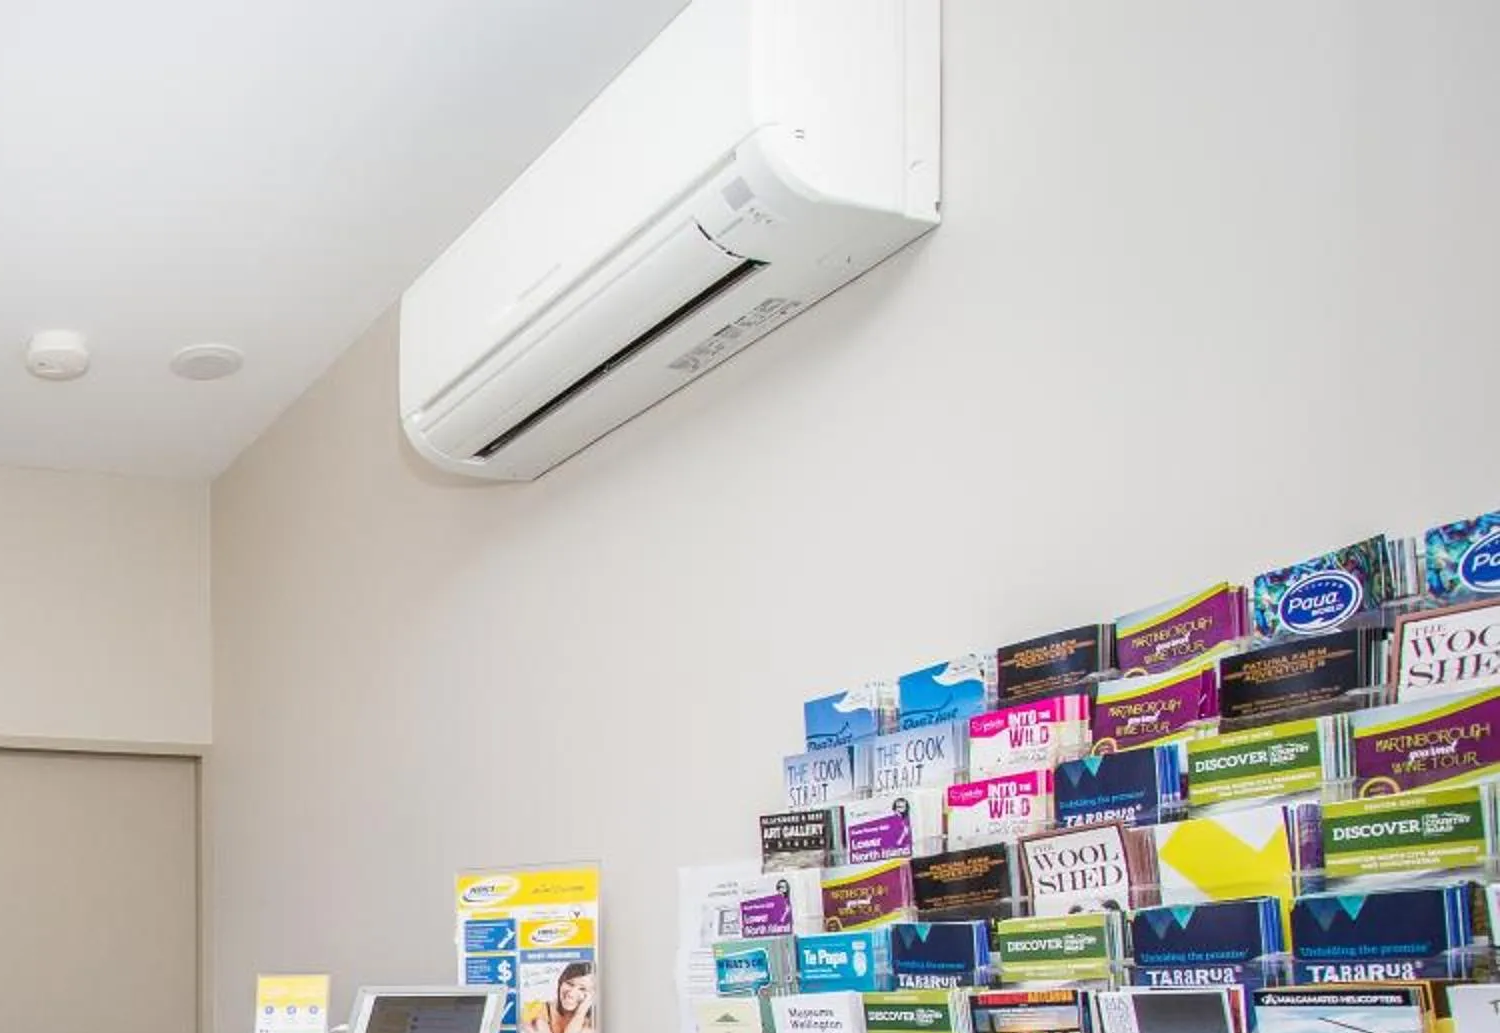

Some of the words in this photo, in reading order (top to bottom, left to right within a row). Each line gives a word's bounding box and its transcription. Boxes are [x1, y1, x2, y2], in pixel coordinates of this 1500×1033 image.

[1410, 624, 1500, 658] WOO
[1407, 652, 1500, 688] SHE
[1007, 709, 1037, 727] INTO
[1008, 725, 1049, 749] WILD
[1376, 723, 1491, 753] MARTINBOROUGH
[876, 744, 901, 766] THE
[905, 735, 946, 763] COOK
[1195, 751, 1268, 773] DISCOVER
[1431, 752, 1480, 770] TOUR
[787, 764, 809, 783] THE
[812, 758, 844, 781] COOK
[876, 764, 924, 792] STRAIT
[987, 781, 1017, 798] INTO
[988, 798, 1031, 819] WILD
[782, 824, 824, 838] GALLERY
[1332, 818, 1421, 841] DISCOVER
[851, 850, 880, 862] North
[1033, 843, 1119, 871] WOOL
[1039, 864, 1122, 895] SHED
[1006, 937, 1063, 953] DISCOVER
[804, 949, 817, 965] Te
[818, 950, 848, 968] Papa
